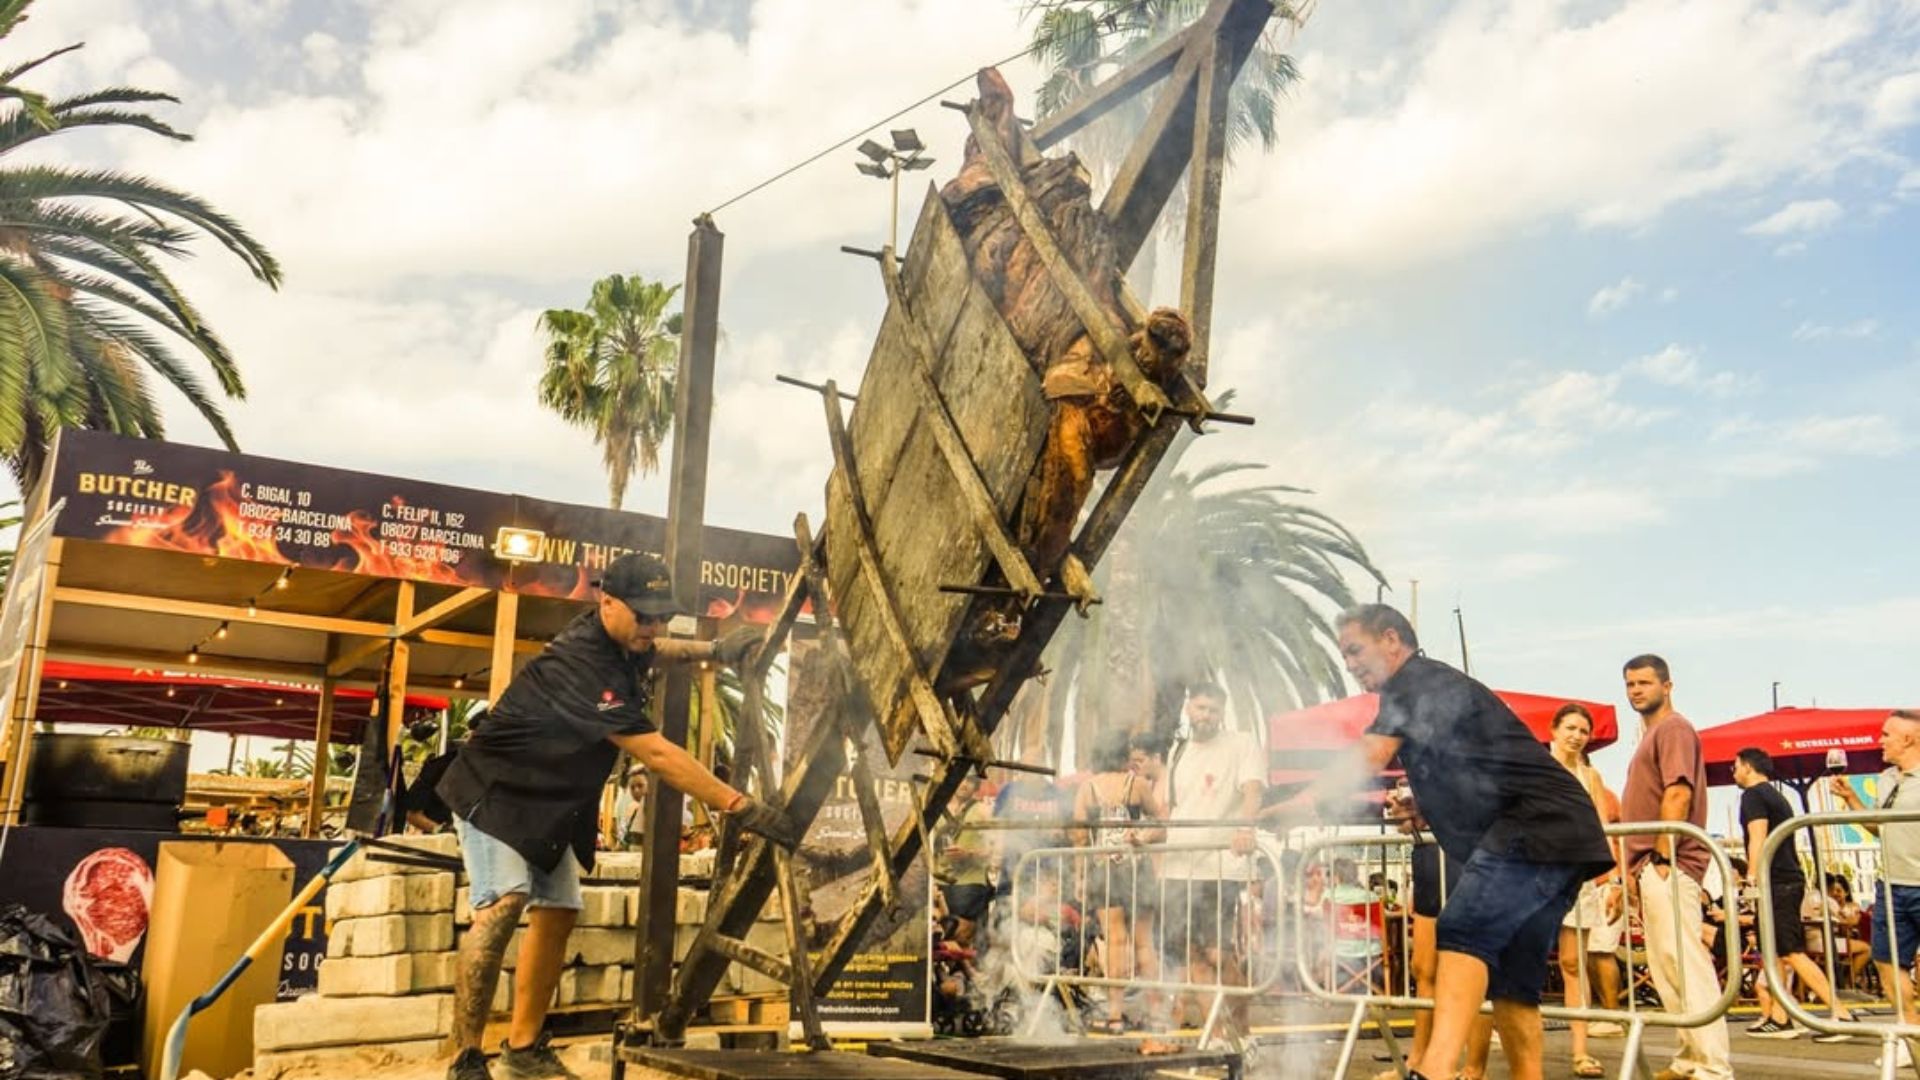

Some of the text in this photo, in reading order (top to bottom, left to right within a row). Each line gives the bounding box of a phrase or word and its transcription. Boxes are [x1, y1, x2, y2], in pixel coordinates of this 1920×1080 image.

[133, 459, 154, 474] The
[79, 474, 196, 505] BUTCHER
[241, 483, 253, 498] C.
[297, 491, 312, 507] 10
[107, 500, 165, 516] SOCIETY
[239, 502, 352, 532] 08022 BARCELONA
[382, 503, 394, 519] C.
[397, 506, 428, 522] FELIP
[445, 513, 465, 529] 162
[275, 526, 293, 543] 34
[294, 528, 312, 545] 30
[313, 532, 330, 548] 88
[381, 523, 484, 549] 08027 BARCELONA
[389, 541, 412, 557] 933
[440, 549, 459, 564] 106
[1795, 736, 1872, 748] ESTRELLA DAMM
